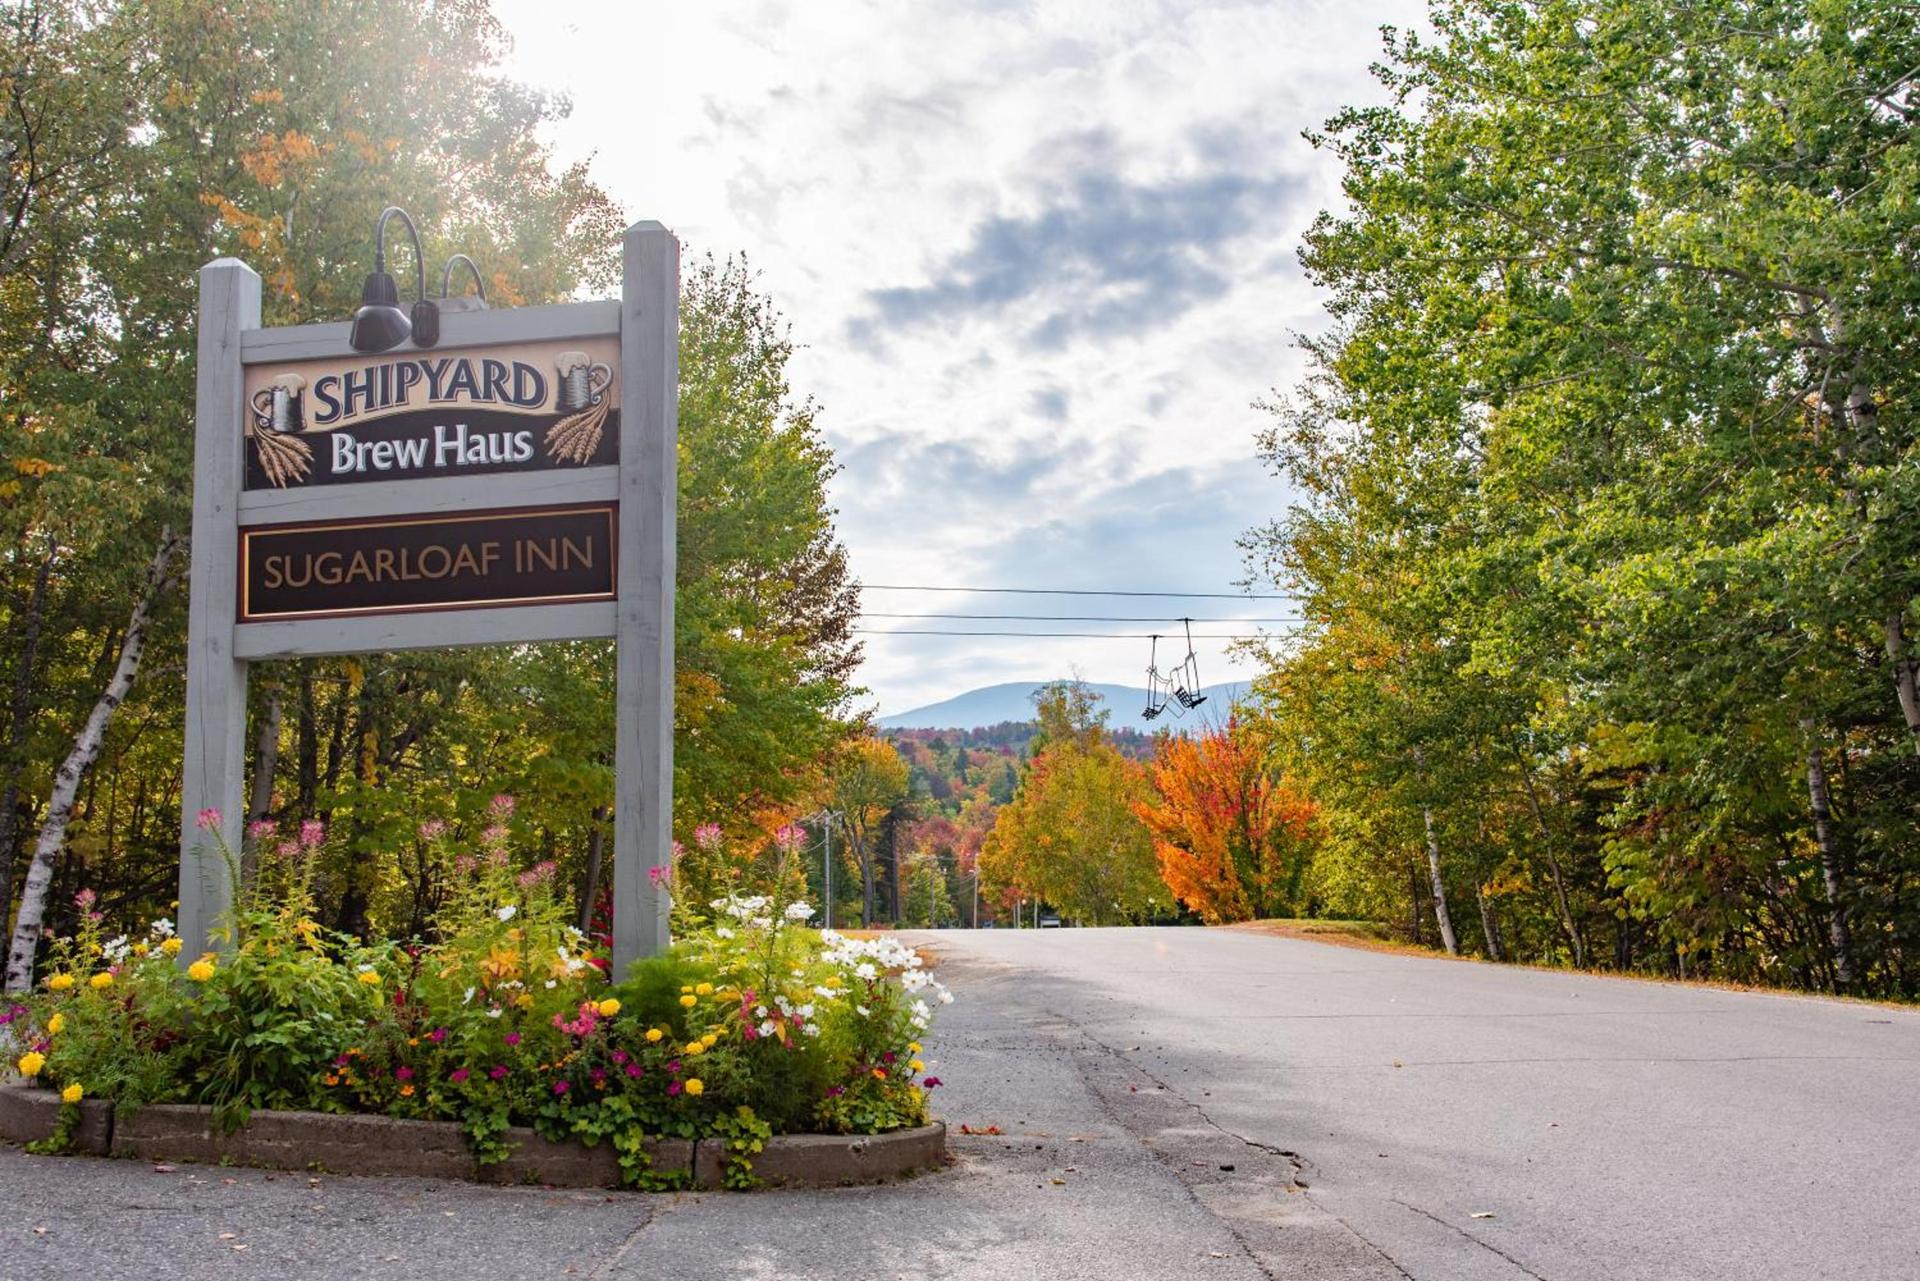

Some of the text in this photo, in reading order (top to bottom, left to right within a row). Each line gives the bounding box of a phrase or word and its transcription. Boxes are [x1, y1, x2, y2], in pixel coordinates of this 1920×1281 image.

[314, 358, 548, 425] SHIPYARD
[331, 424, 534, 475] Brew Haus
[264, 536, 593, 589] SUGARLOAF INN
